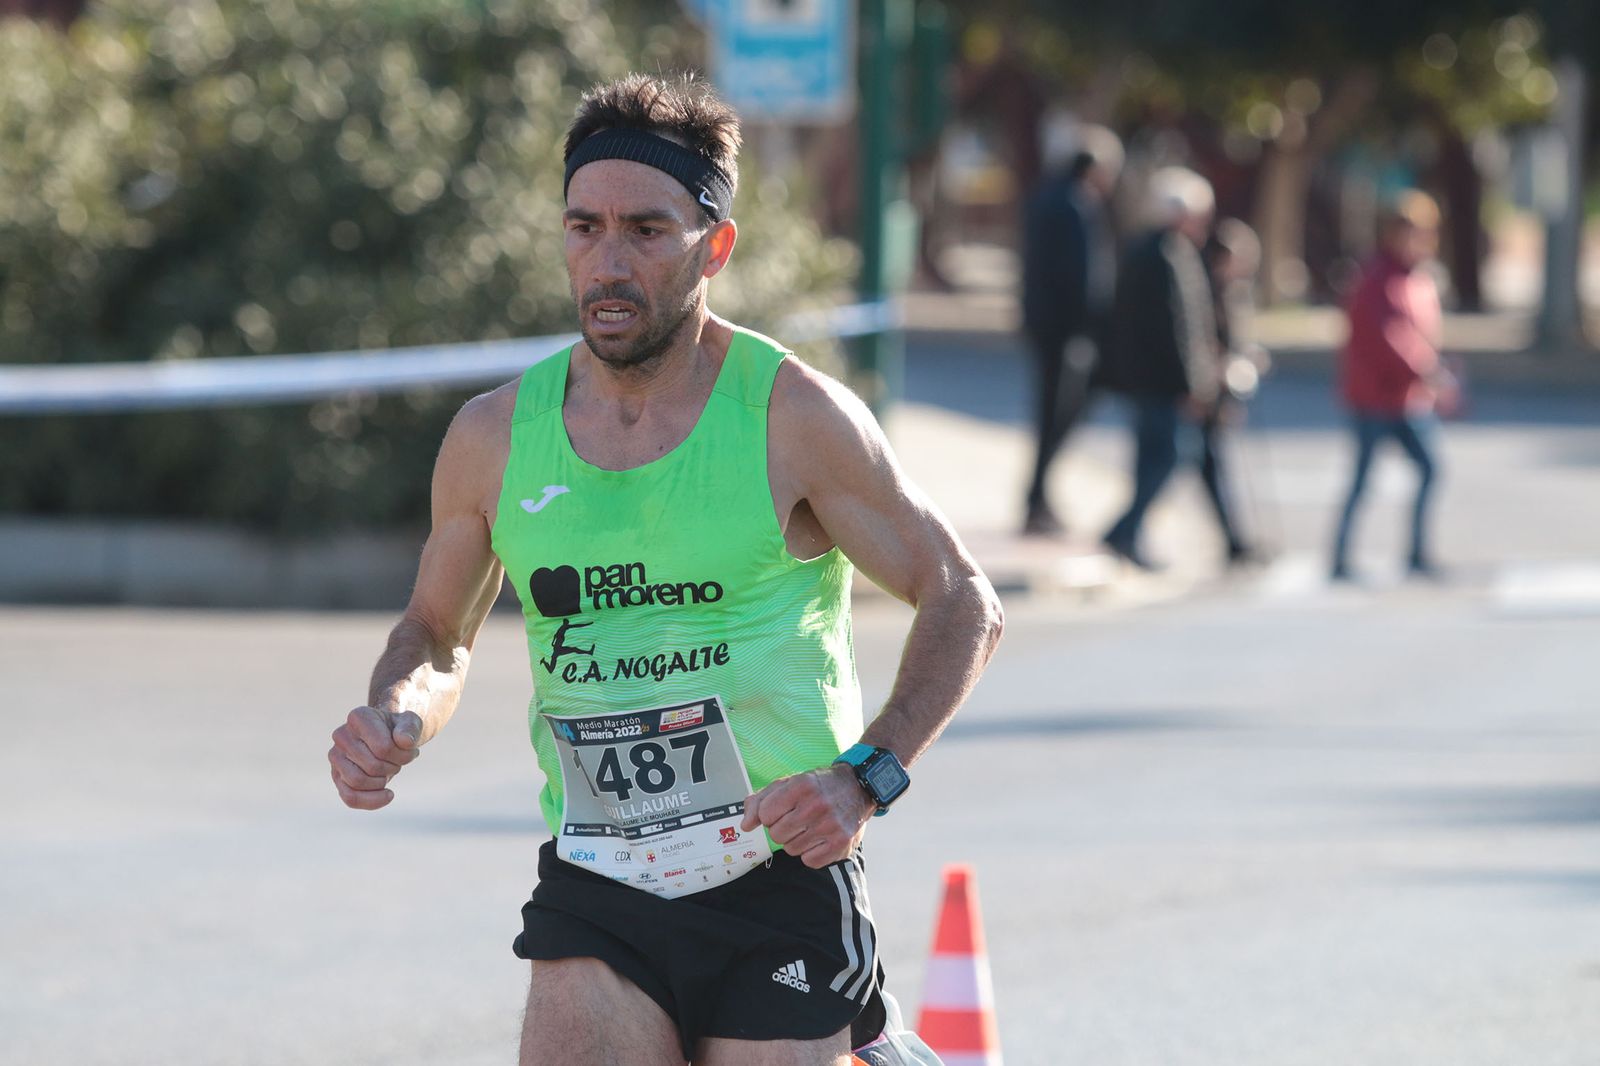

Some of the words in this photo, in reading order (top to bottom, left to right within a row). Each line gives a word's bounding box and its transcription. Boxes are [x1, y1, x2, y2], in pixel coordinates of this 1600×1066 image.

[584, 562, 647, 597] pan
[593, 581, 723, 611] moreno
[562, 661, 608, 683] C.A.
[613, 643, 731, 682] NOGALTE
[577, 720, 602, 730] Medio
[604, 717, 641, 728] Maratón
[580, 728, 614, 740] Almería
[661, 841, 695, 854] ALMERÍA
[569, 850, 596, 862] NEXA
[615, 850, 631, 861] CDX
[772, 972, 811, 993] adidas
